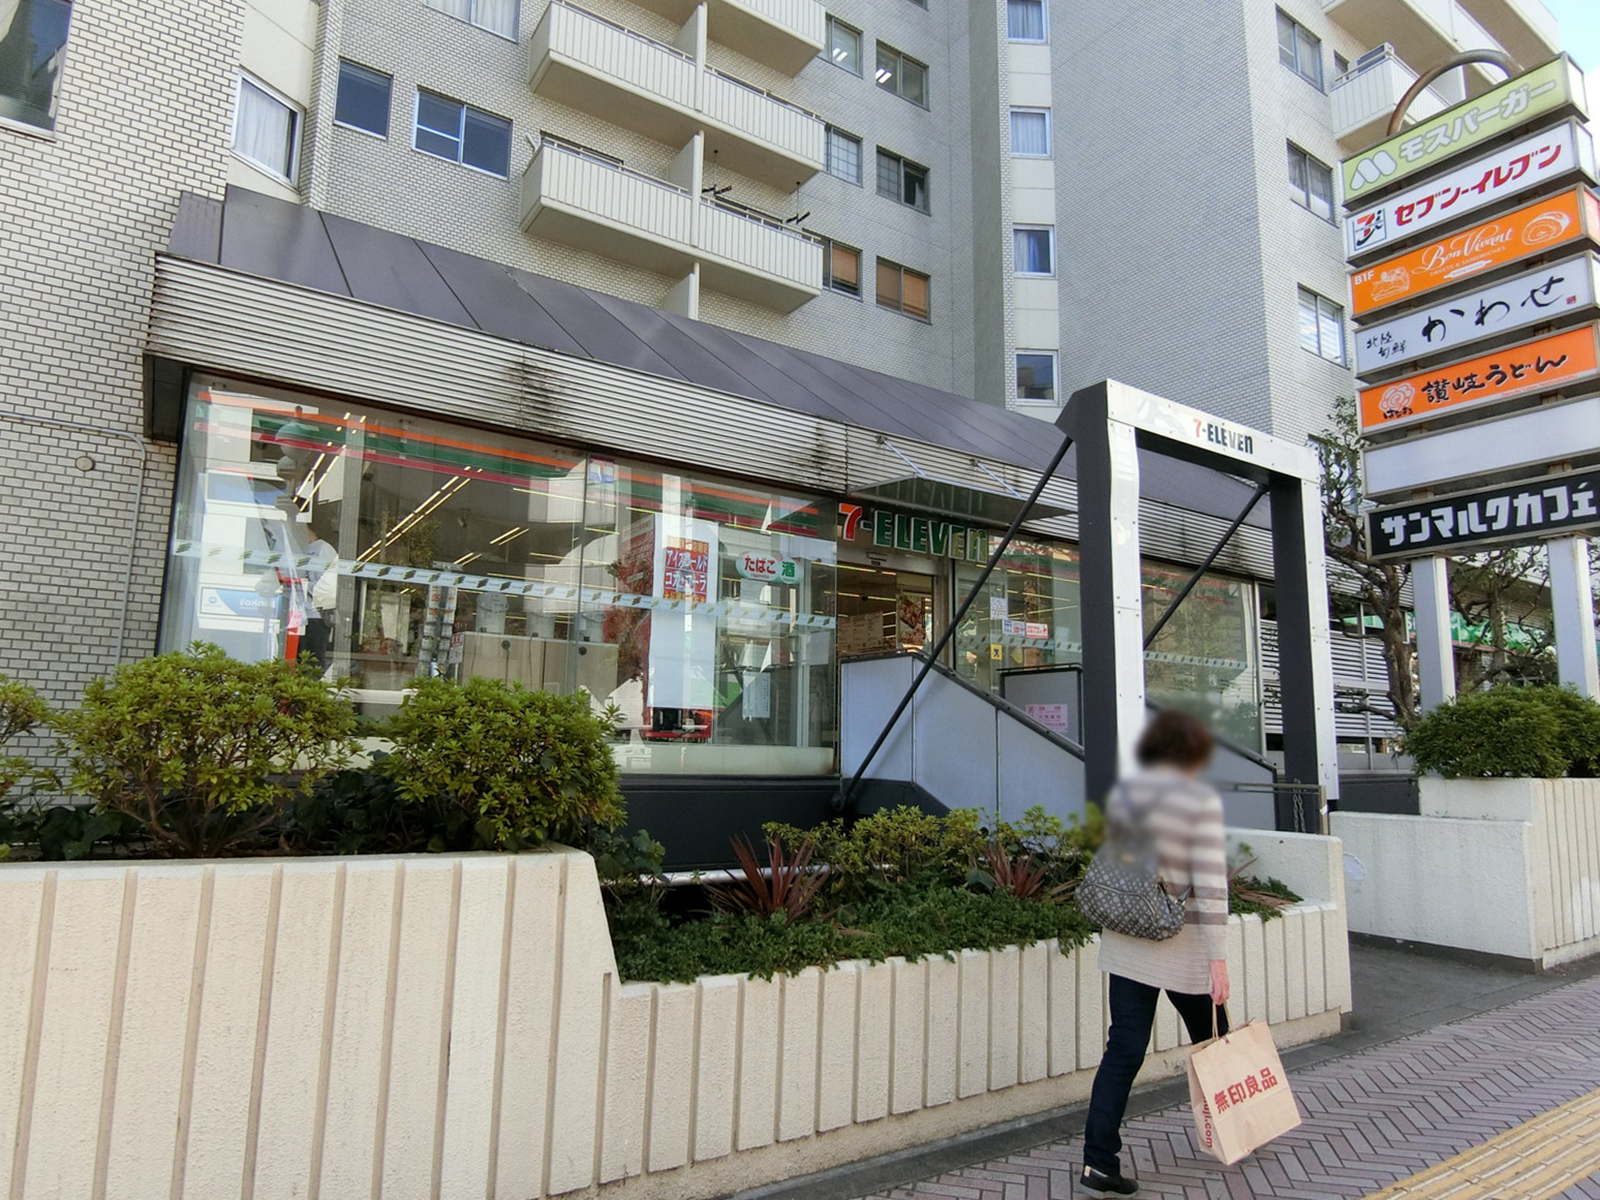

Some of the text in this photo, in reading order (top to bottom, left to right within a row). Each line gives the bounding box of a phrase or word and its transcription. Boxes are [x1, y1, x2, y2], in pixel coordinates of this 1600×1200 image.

[1399, 80, 1557, 162] モスバーガー
[1412, 245, 1461, 275] Bon
[1450, 225, 1513, 256] Vivant
[1354, 270, 1375, 285] B1F
[1422, 276, 1565, 342] かわせ
[1380, 482, 1597, 547] サンマルクカフェ
[666, 550, 709, 571] アイスールド
[744, 556, 776, 574] たばこ
[781, 561, 796, 577] 酒
[1214, 1067, 1278, 1114] 無印良品
[1202, 1097, 1213, 1149] uji.com
